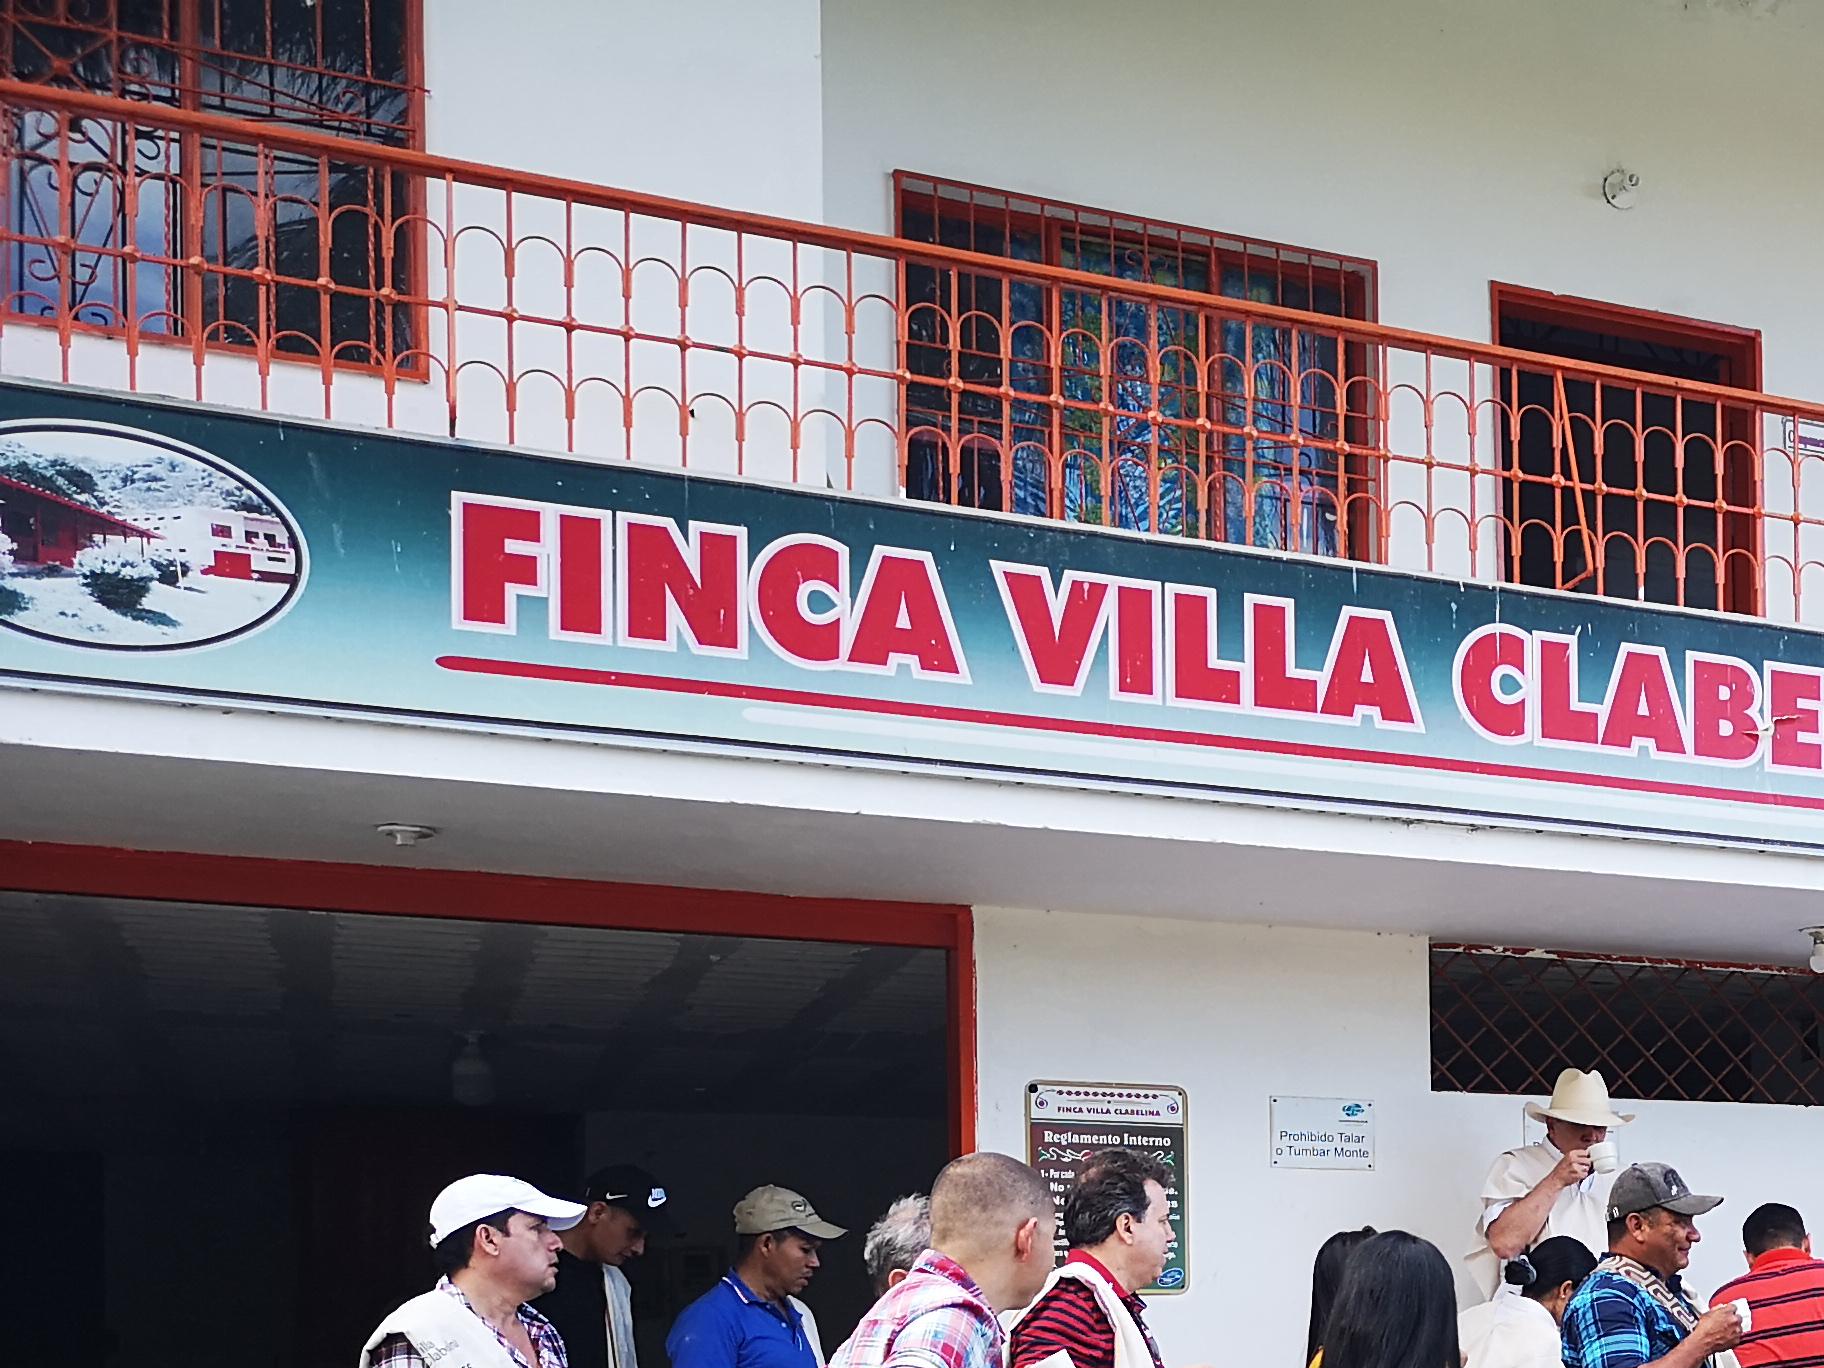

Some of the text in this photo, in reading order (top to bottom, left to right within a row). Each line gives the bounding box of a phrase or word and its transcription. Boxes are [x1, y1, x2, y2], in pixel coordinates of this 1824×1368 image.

[451, 491, 972, 685] FINCA
[989, 559, 1426, 733] VILLA
[1057, 1106, 1161, 1117] FINCA VILLA CLABELINA
[1043, 1131, 1172, 1147] Reglamento Interno
[1279, 1130, 1366, 1144] Prohibido Talar
[1275, 1145, 1370, 1158] o Tumbar Monte
